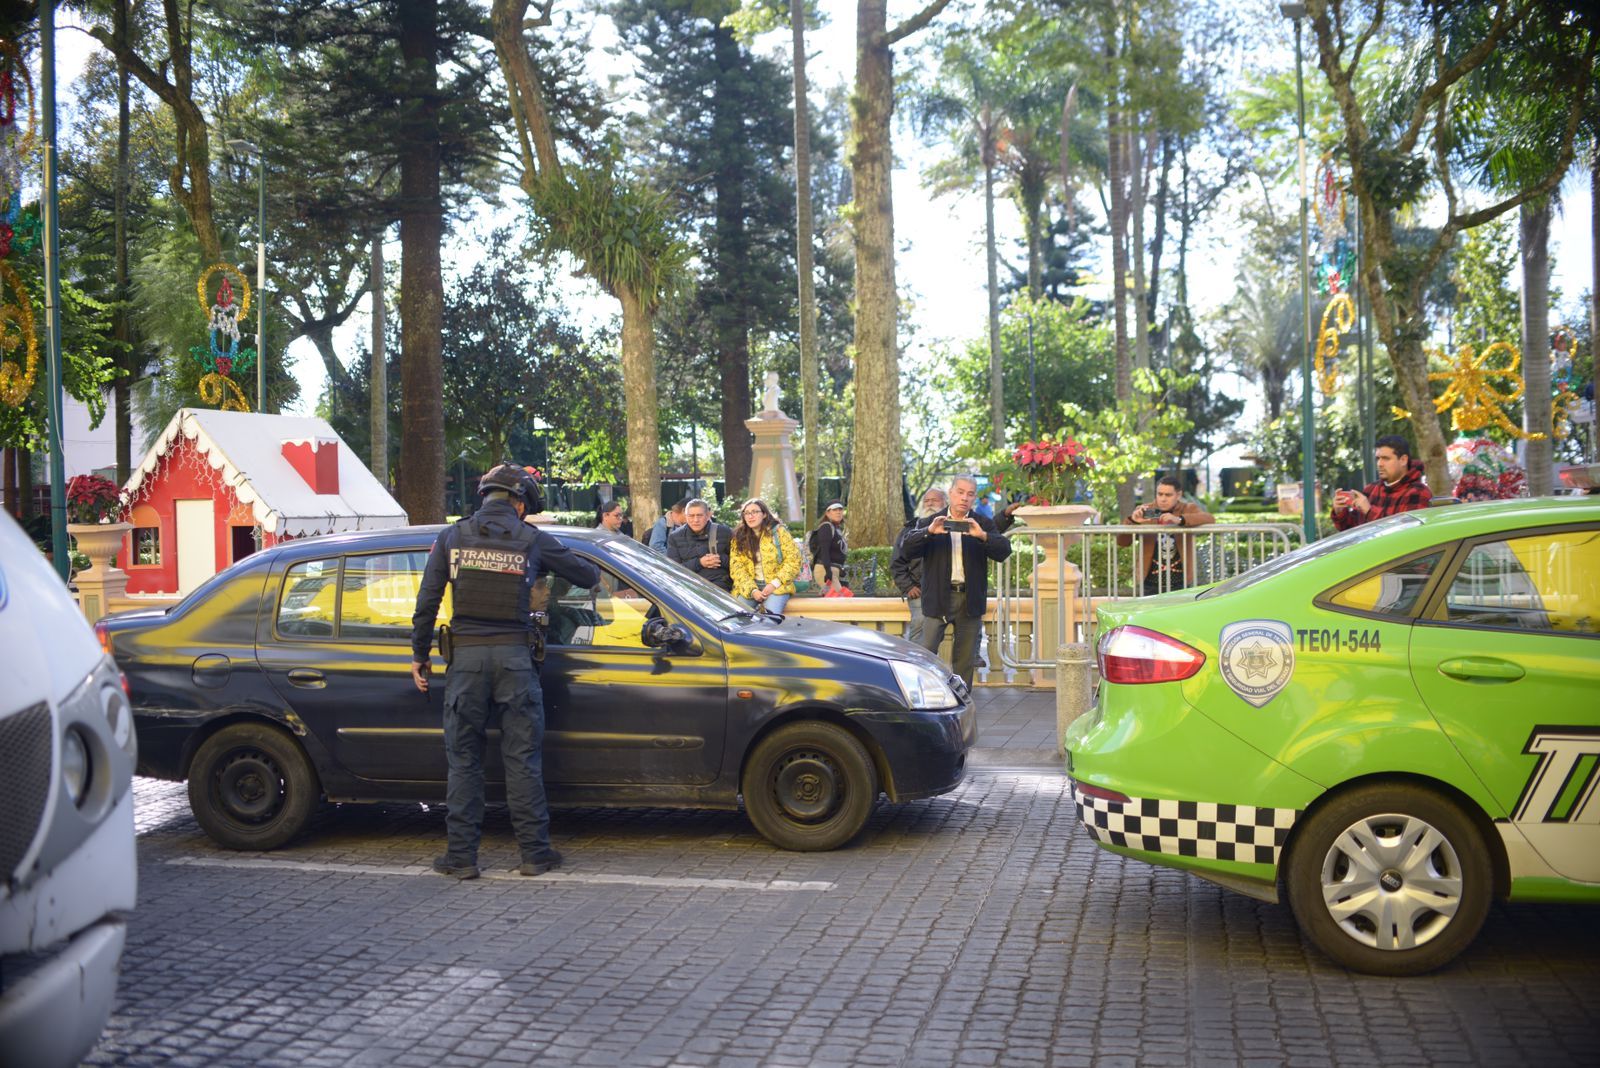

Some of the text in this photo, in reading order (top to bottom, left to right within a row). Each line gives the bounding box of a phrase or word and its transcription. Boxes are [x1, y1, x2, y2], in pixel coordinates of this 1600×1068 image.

[460, 559, 524, 572] MUNICIPAL
[461, 549, 524, 564] TRANSITO
[1296, 629, 1381, 653] TE01-544
[1227, 672, 1253, 693] SEGURIDAD
[1266, 683, 1278, 691] DEL
[1275, 667, 1290, 685] ESTADO
